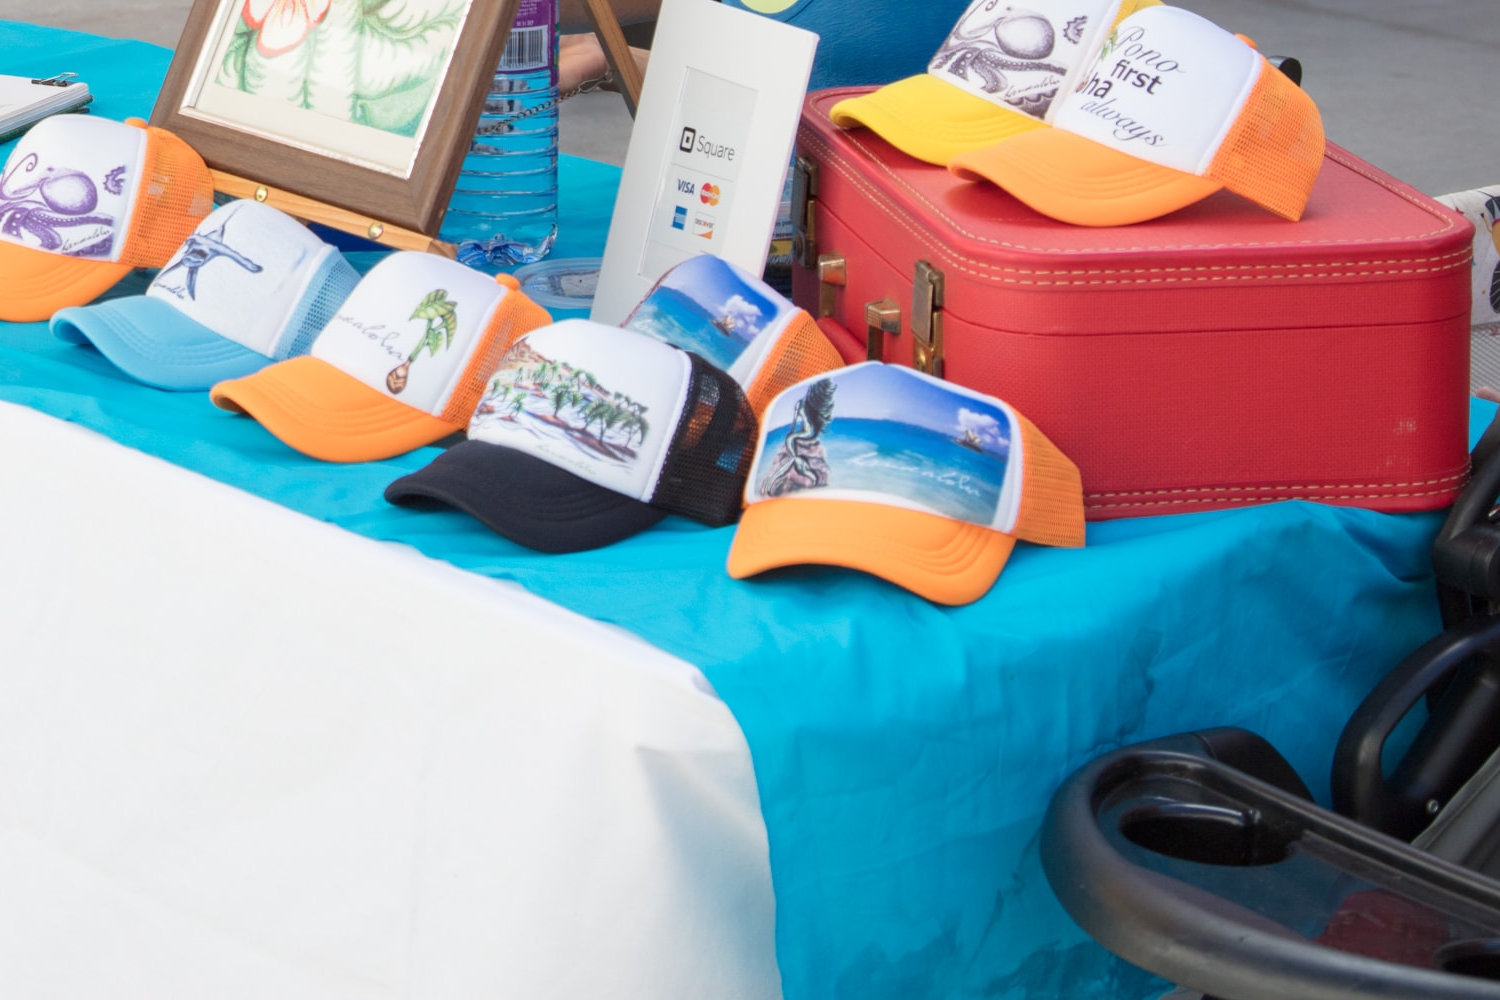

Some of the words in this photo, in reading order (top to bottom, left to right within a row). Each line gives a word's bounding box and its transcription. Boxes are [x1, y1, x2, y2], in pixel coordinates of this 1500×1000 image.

[1115, 26, 1186, 74] Pono
[1110, 59, 1162, 95] first
[1080, 98, 1168, 147] always
[696, 135, 735, 161] Square
[677, 178, 695, 195] VISA
